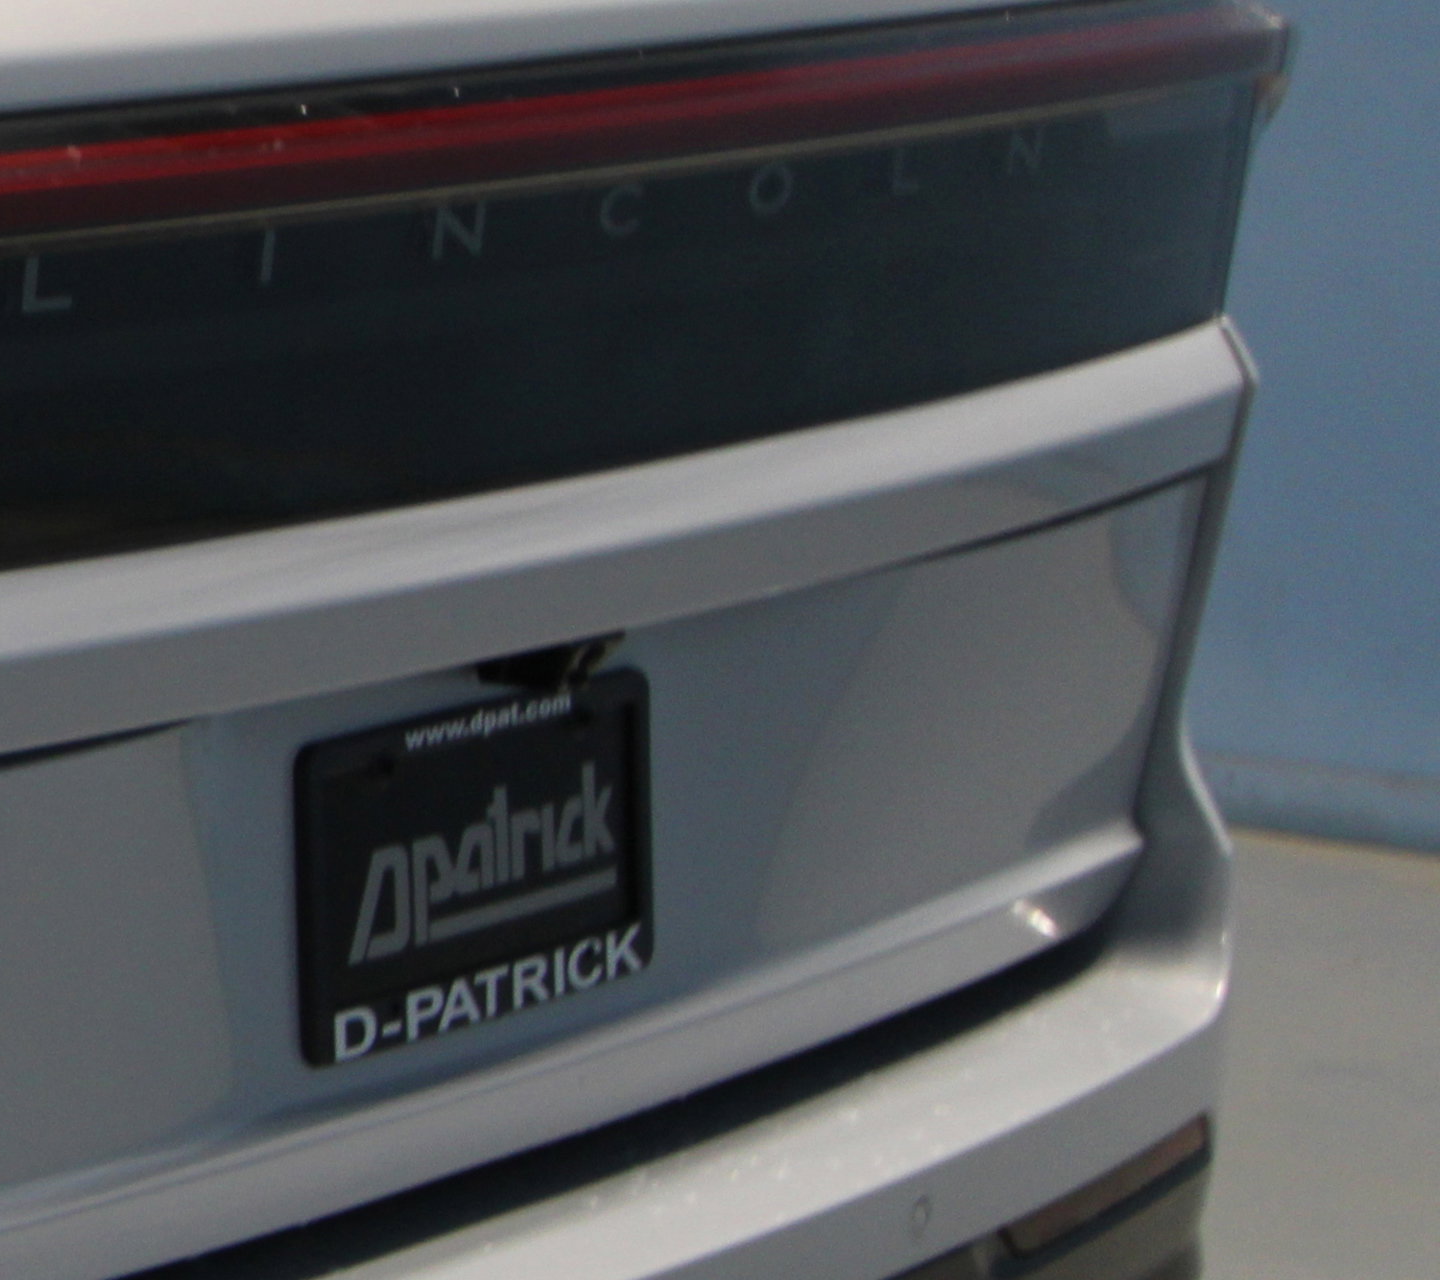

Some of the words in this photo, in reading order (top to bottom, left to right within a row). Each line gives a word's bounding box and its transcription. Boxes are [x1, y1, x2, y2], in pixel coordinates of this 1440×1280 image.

[20, 124, 1048, 316] LINCOLN
[404, 693, 573, 752] www.dpat.com
[332, 921, 644, 1064] D-PATRICK
